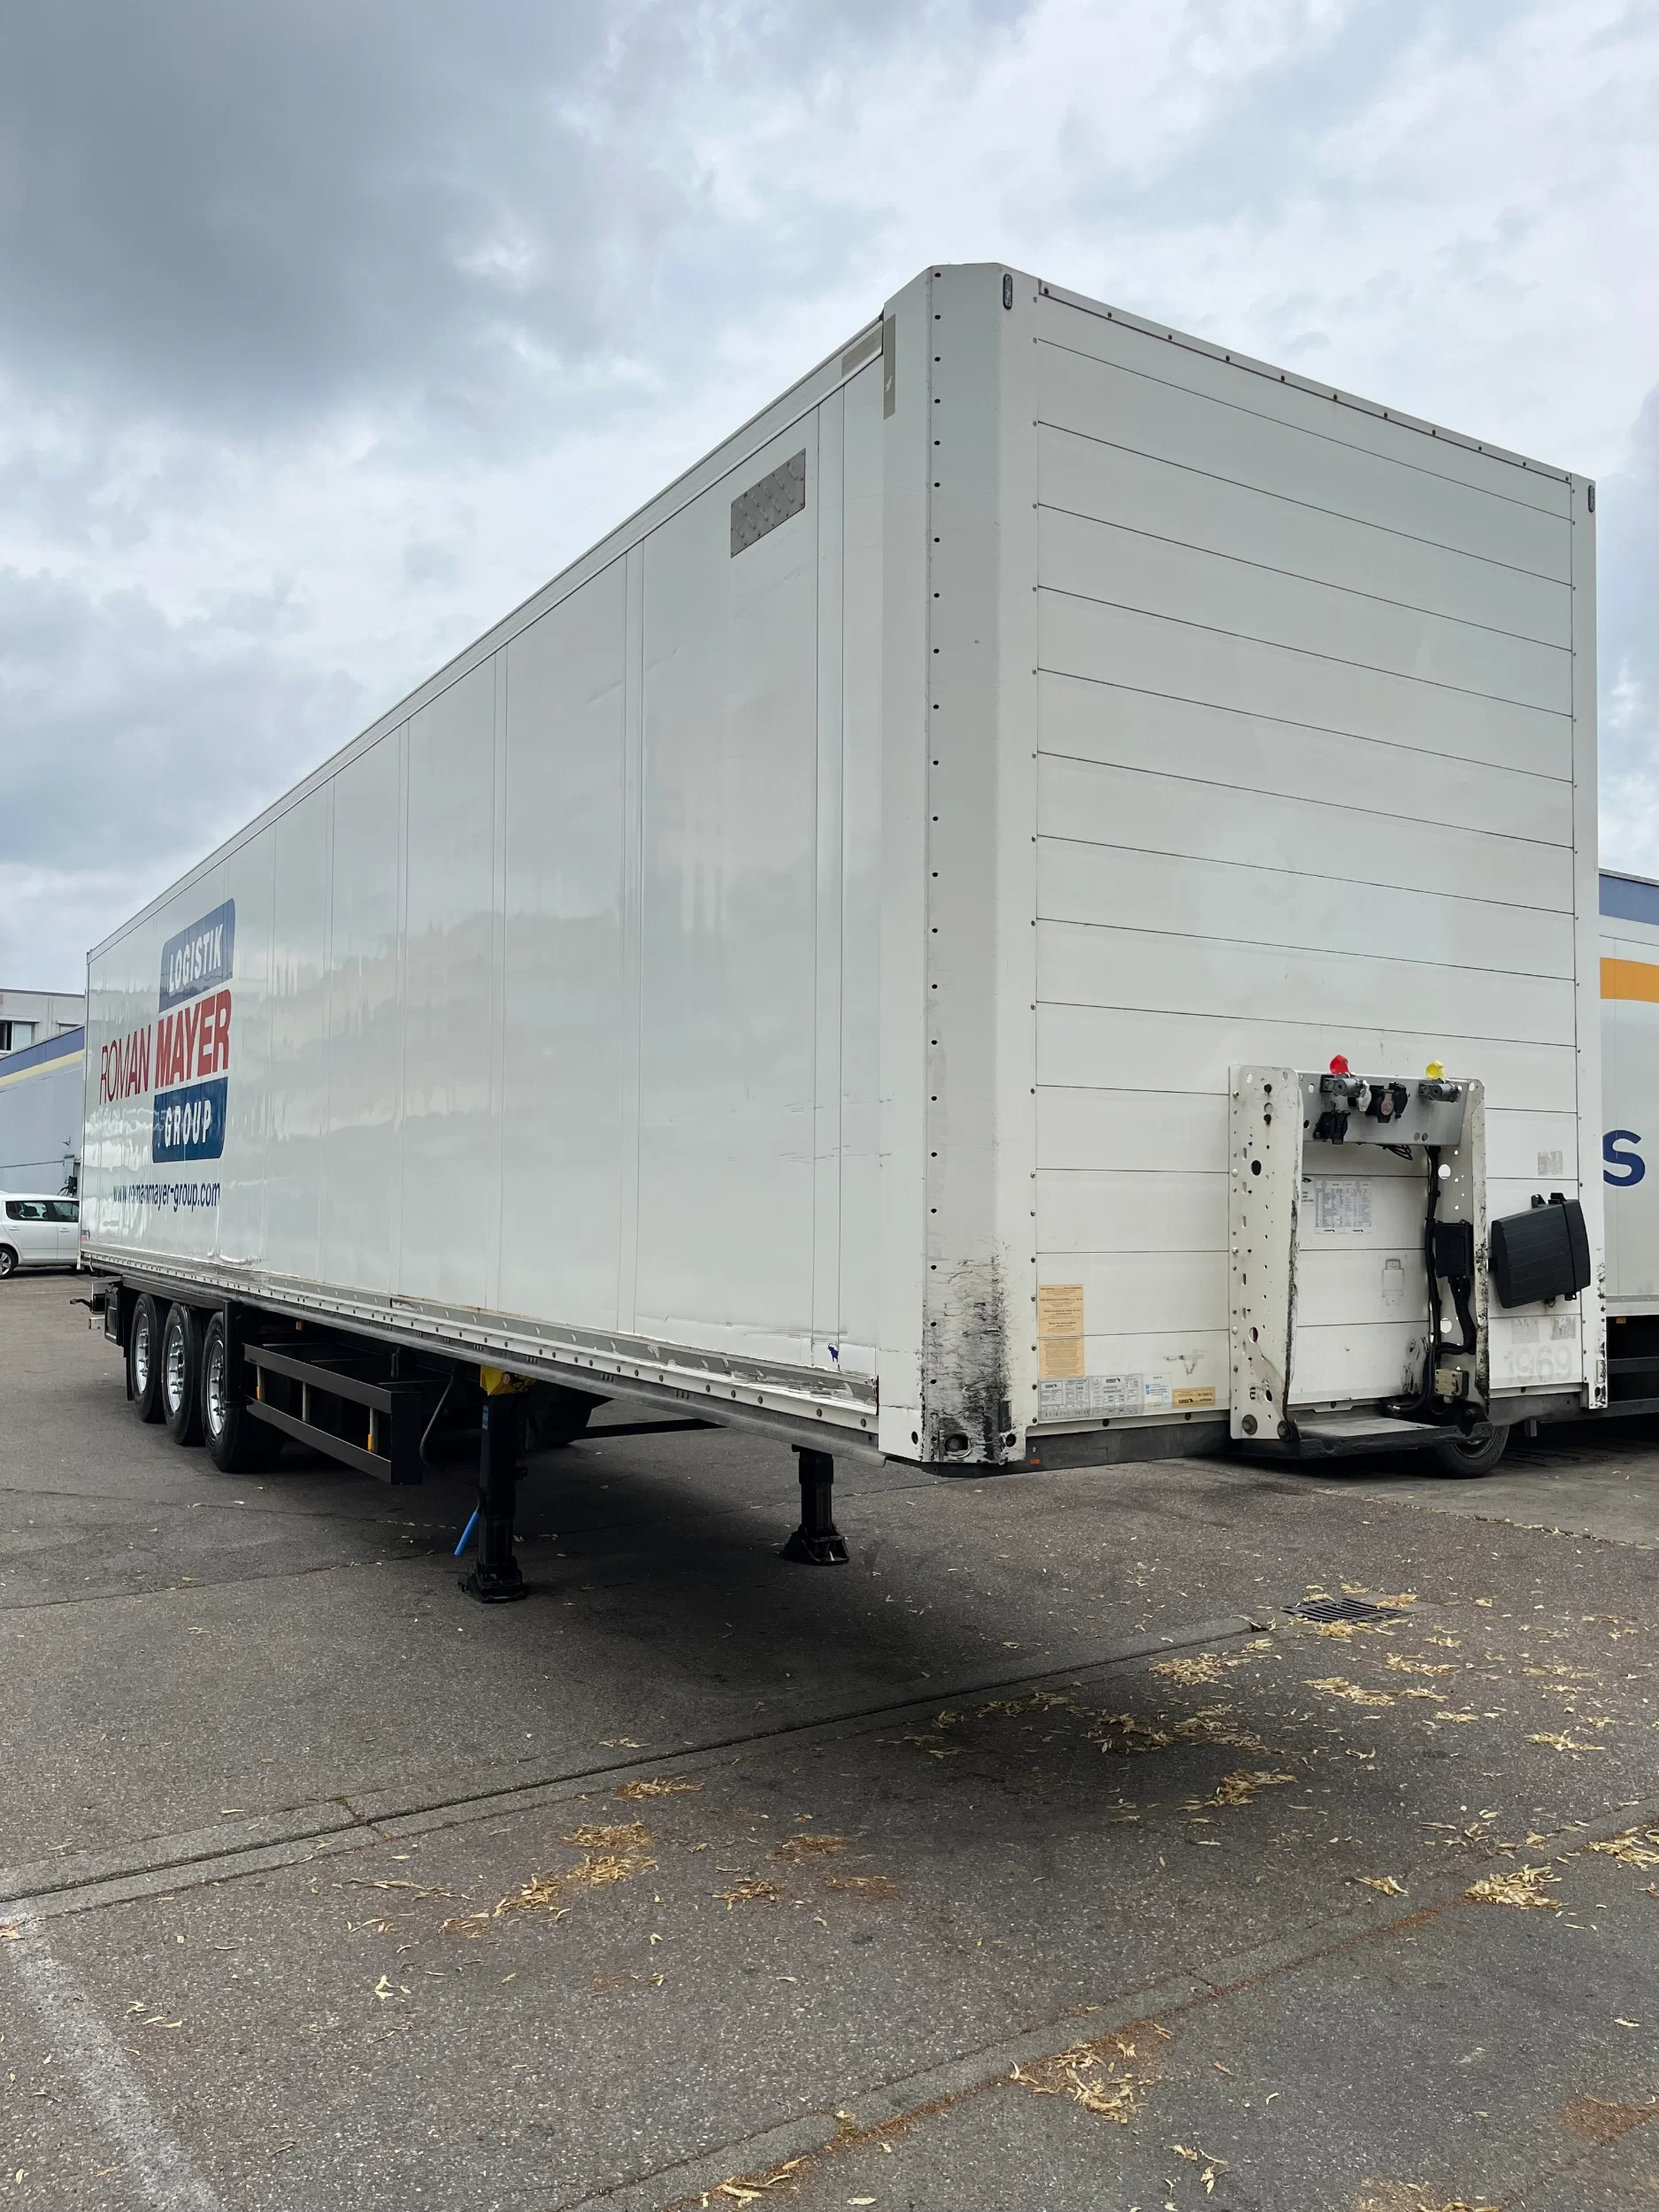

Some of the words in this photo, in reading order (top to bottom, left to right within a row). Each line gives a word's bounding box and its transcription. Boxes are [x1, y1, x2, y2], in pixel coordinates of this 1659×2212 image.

[168, 923, 224, 995] LOGISTIK
[99, 1024, 151, 1105] ROMAN
[155, 988, 231, 1089] MAYER
[164, 1099, 211, 1148] GROUP
[1603, 1129, 1646, 1187] S
[113, 1182, 220, 1212] www.romanmayer-group.com
